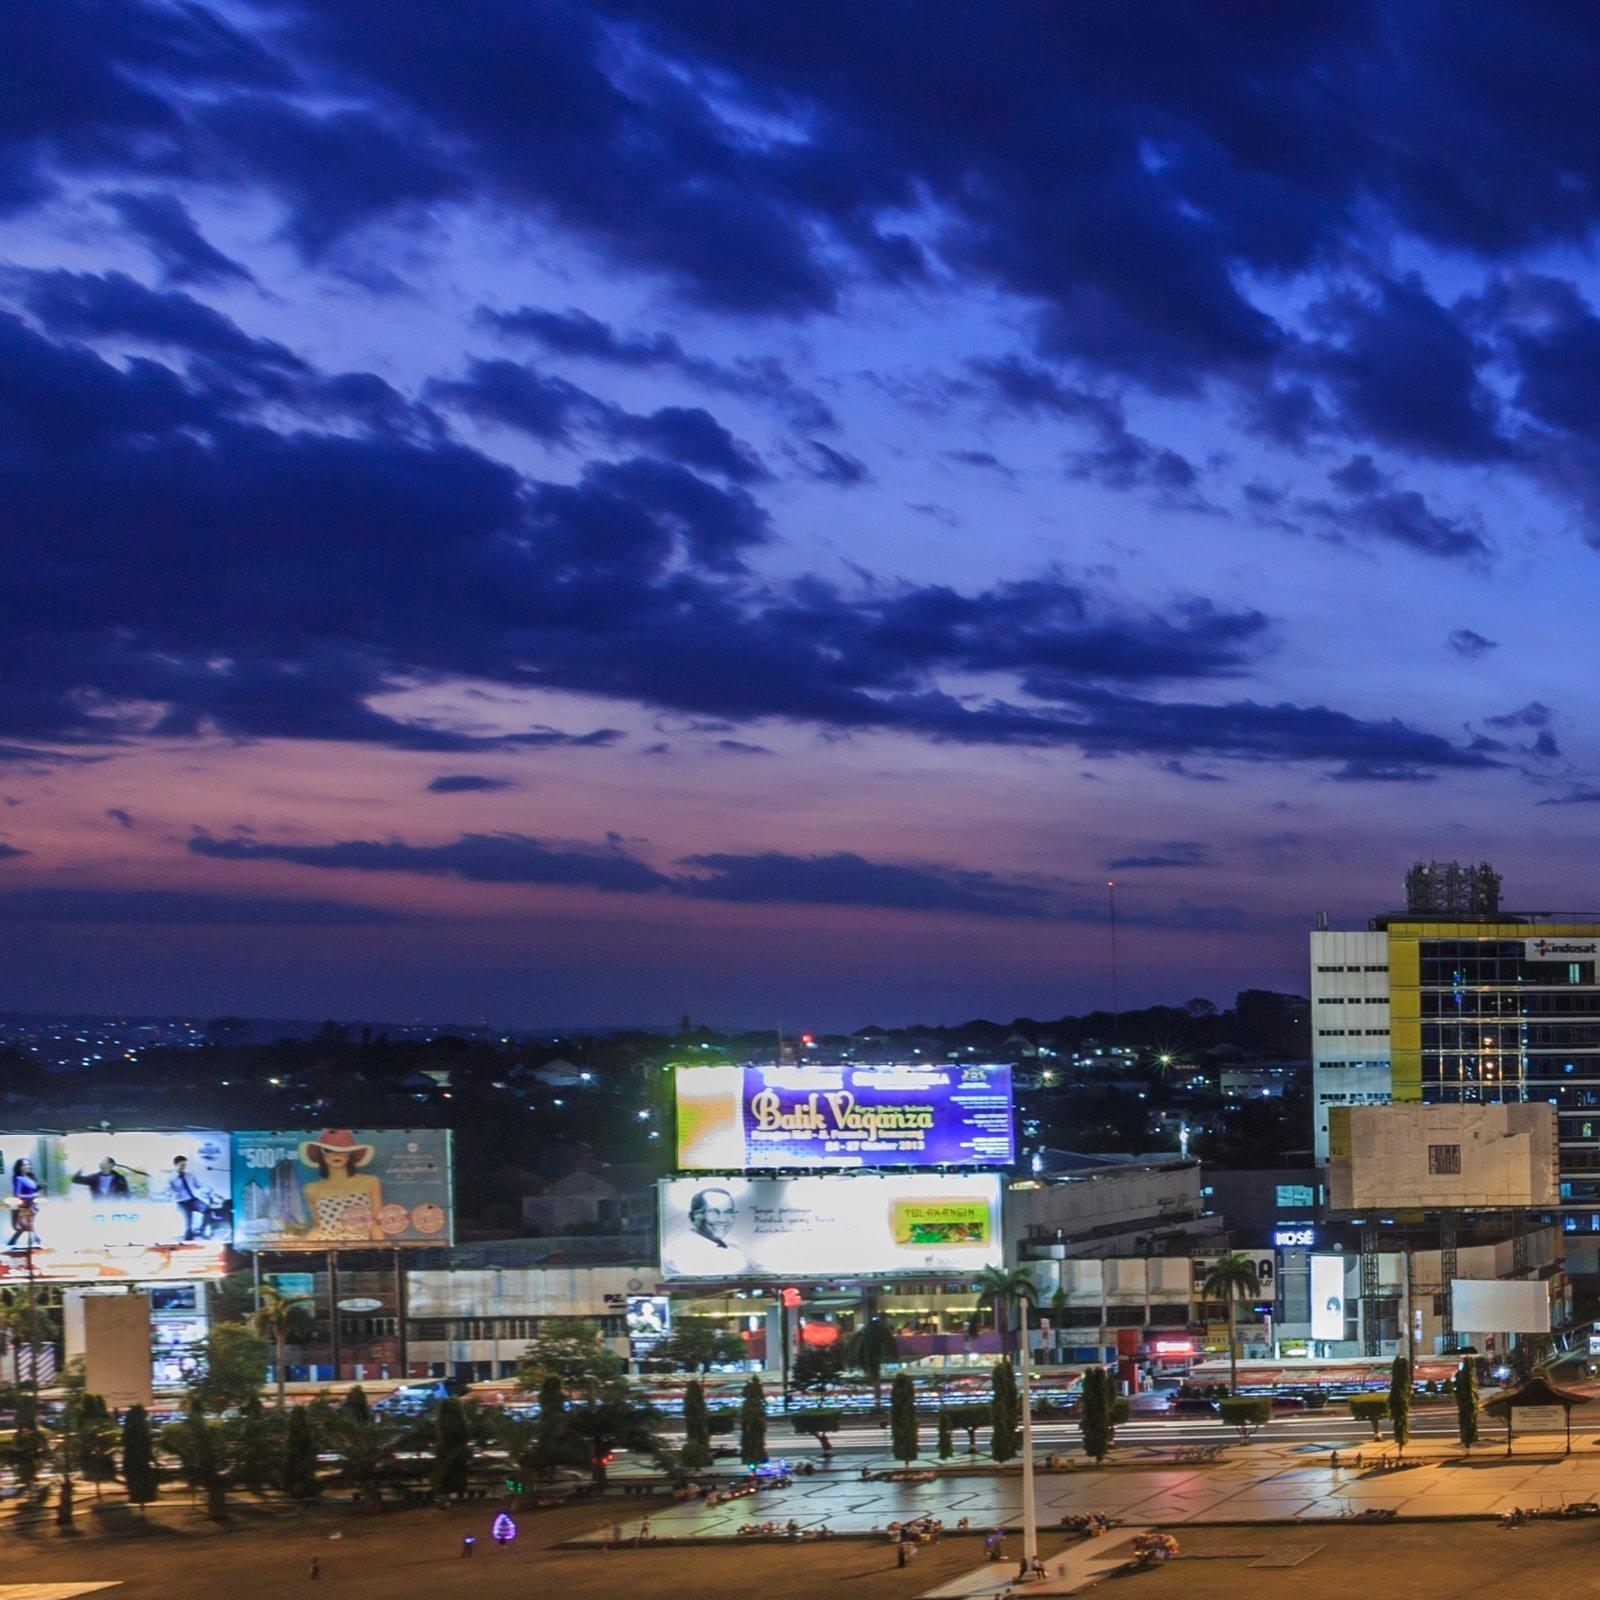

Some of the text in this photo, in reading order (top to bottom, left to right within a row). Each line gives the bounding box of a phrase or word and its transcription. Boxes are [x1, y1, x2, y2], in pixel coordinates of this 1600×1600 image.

[1551, 943, 1597, 953] indosat
[752, 1088, 827, 1130] Batik
[823, 1091, 934, 1141] Vaganza
